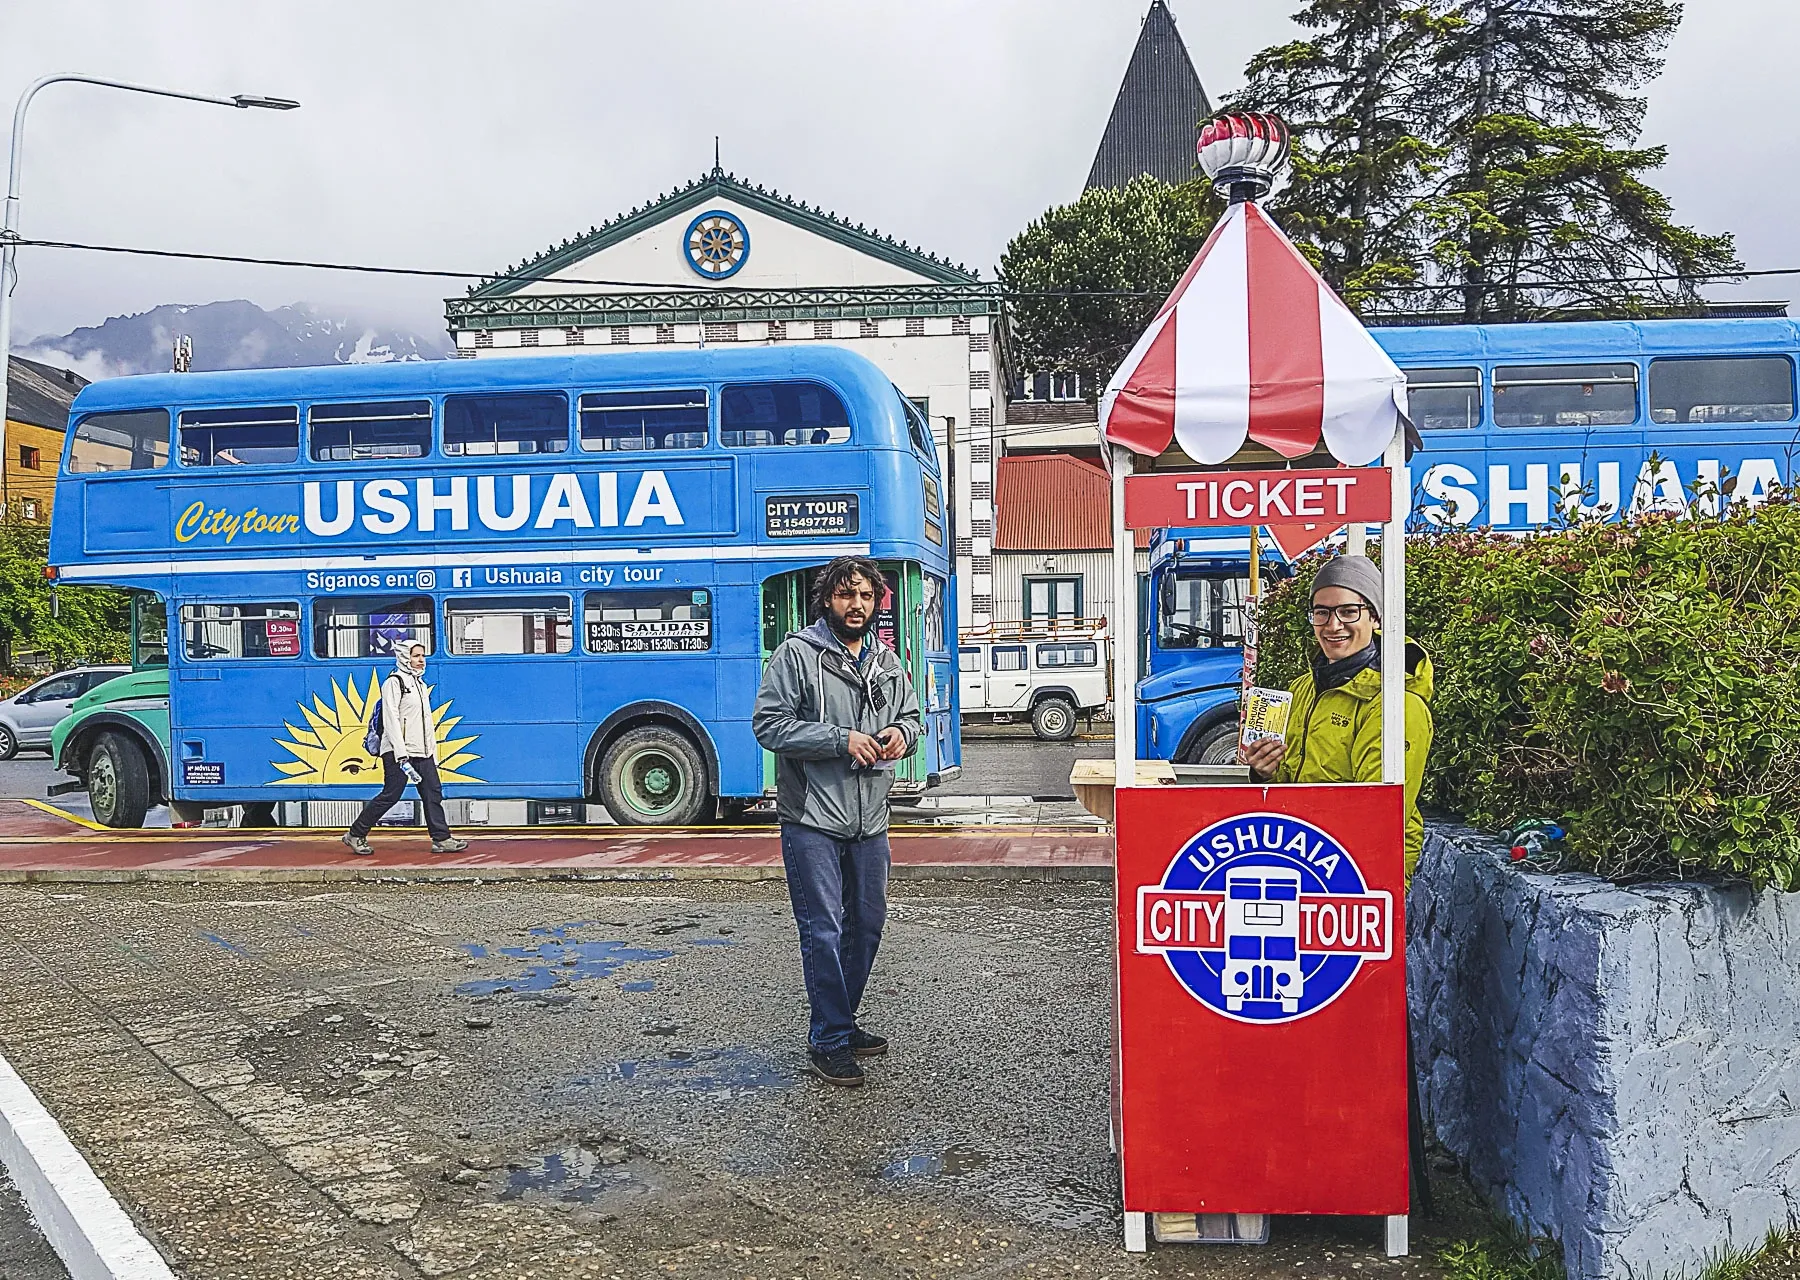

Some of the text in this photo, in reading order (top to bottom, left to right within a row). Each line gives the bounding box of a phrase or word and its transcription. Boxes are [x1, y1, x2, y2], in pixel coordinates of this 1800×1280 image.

[303, 470, 685, 536] USHUAIA
[1176, 477, 1357, 519] TICKET
[1405, 459, 1783, 524] SHUAIA
[767, 501, 848, 516] CITY TOUR
[783, 516, 844, 528] 15497788
[306, 570, 414, 592] Síganos en:
[485, 565, 664, 586] Ushuaia city tour
[624, 622, 705, 632] SALIDAS
[1247, 699, 1261, 730] USHUAIA
[1188, 824, 1341, 879] USHUAIA
[1150, 900, 1382, 947] CITY TOUR
